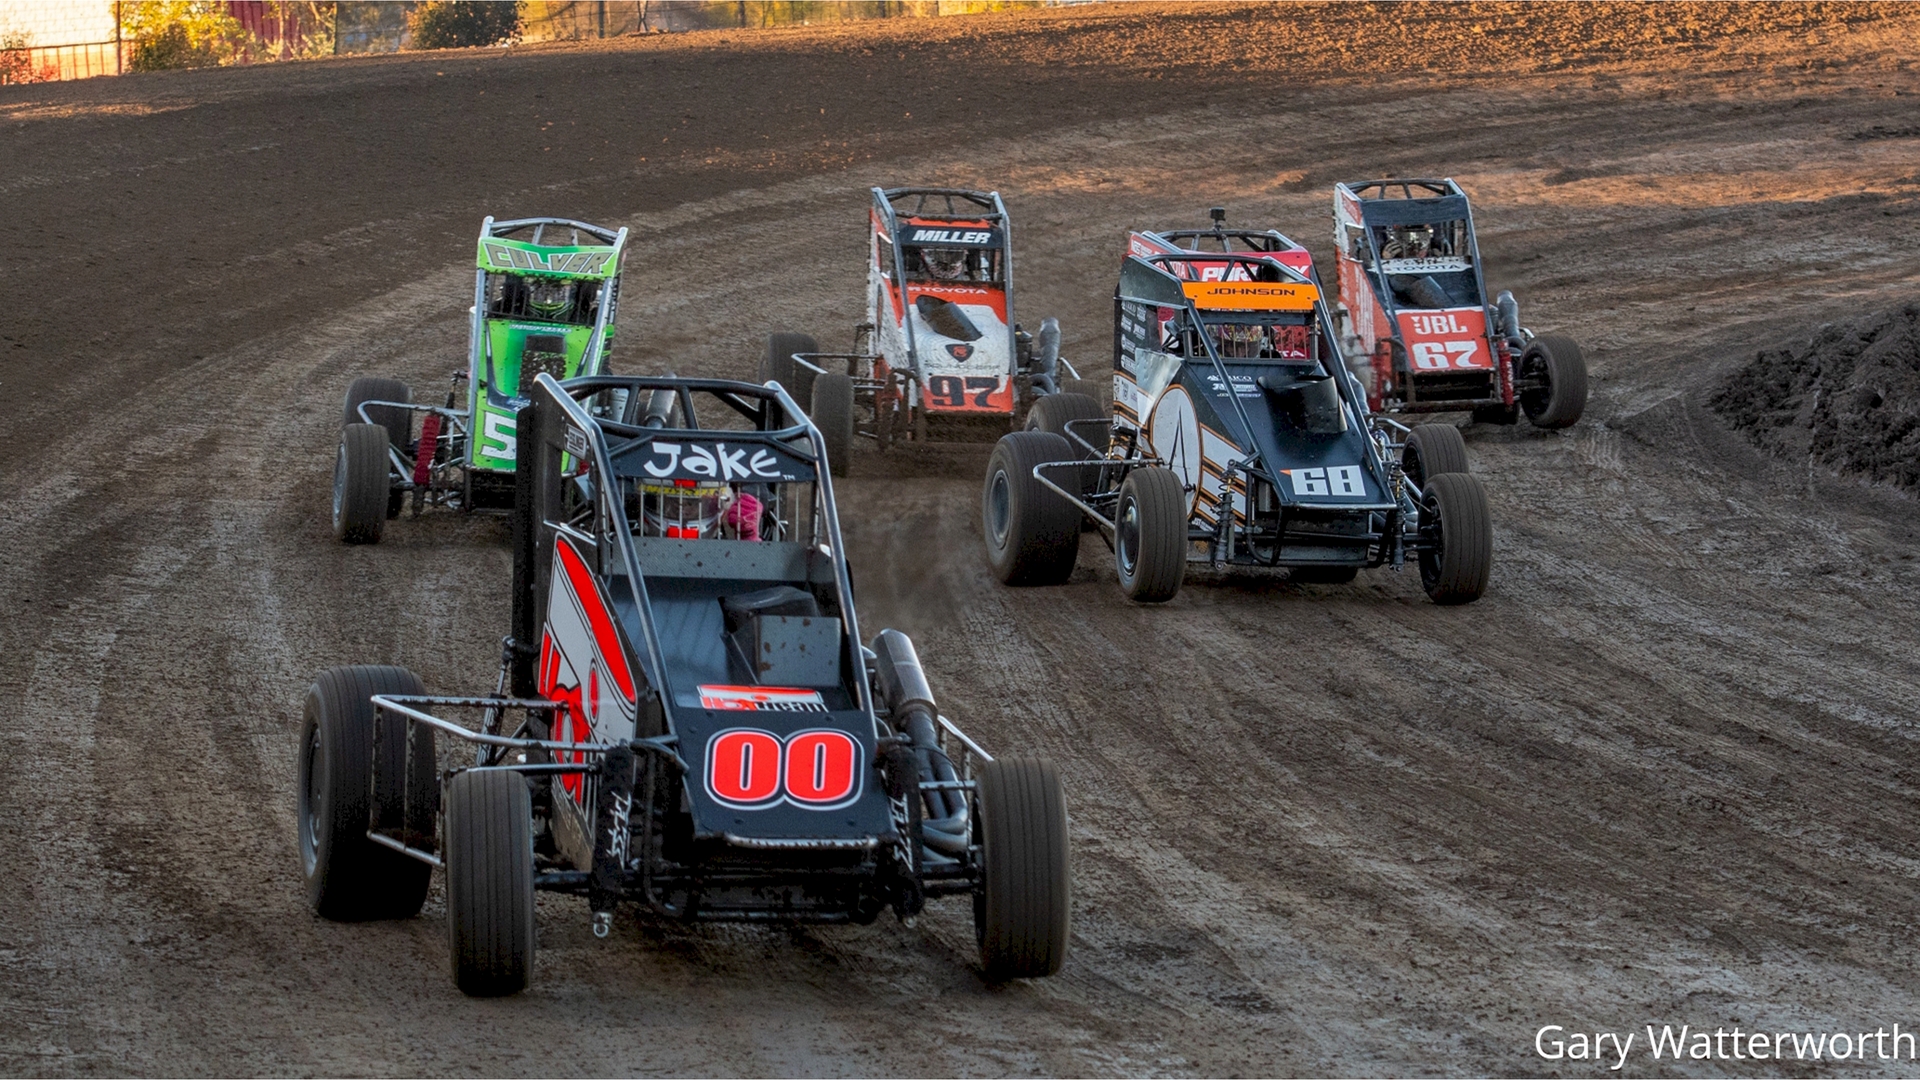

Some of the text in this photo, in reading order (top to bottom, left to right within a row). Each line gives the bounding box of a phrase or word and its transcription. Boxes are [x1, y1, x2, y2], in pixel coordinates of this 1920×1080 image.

[912, 229, 991, 244] MILLER
[484, 242, 614, 275] CULVER
[1395, 264, 1461, 272] TOYOTA
[924, 286, 989, 295] TOYOTA
[1207, 287, 1296, 297] JOHNSON
[1414, 315, 1468, 335] JBL
[1411, 340, 1482, 370] 67
[929, 376, 1002, 409] 97
[1290, 465, 1367, 497] 68
[707, 729, 862, 808] 00
